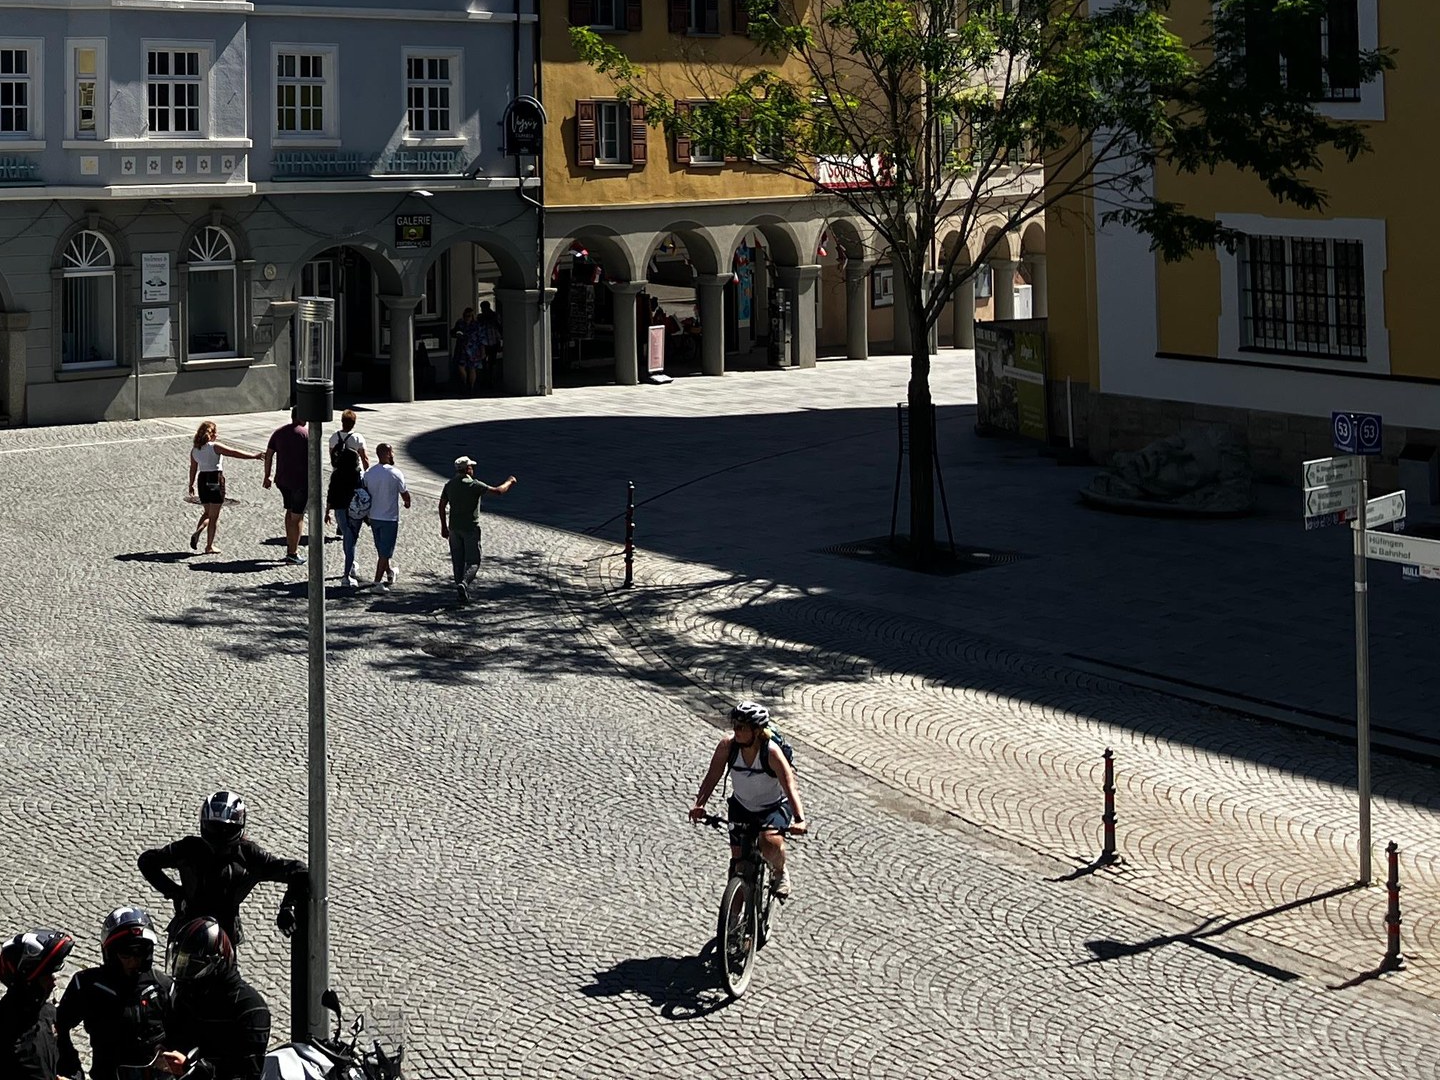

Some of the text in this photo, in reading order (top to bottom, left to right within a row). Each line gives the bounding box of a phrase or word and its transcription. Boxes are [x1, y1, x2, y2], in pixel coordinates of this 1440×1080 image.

[396, 215, 432, 226] GALERIE
[1337, 421, 1348, 437] 53
[1363, 424, 1375, 439] 53
[1369, 535, 1404, 549] Hüfingen
[1379, 548, 1411, 560] Bahnhof
